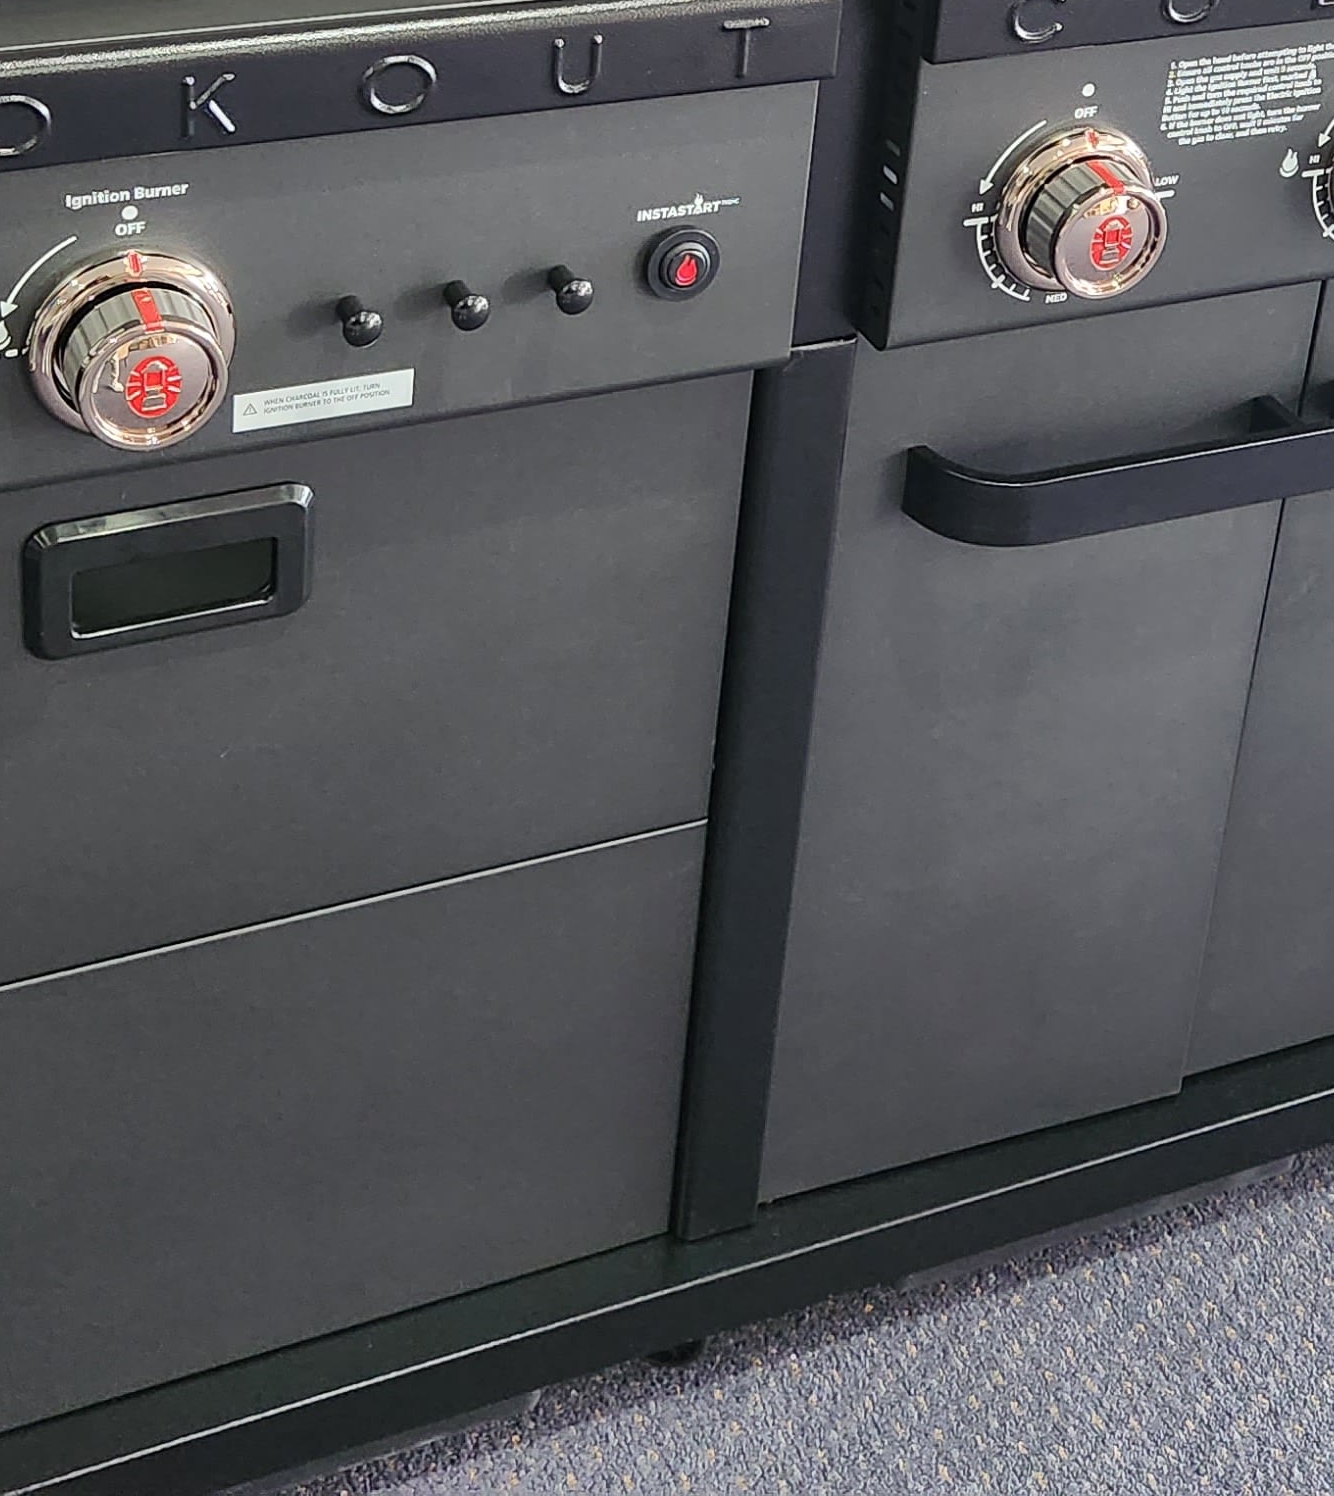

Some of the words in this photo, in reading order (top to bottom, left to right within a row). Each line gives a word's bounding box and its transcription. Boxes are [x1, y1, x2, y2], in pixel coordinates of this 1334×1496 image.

[1074, 105, 1098, 119] OFF
[1309, 155, 1320, 164] HI
[1154, 174, 1180, 186] LOW
[65, 191, 130, 209] Ignition
[133, 182, 189, 201] Burner
[636, 201, 722, 222] INSTASTART
[971, 202, 984, 213] HI
[115, 221, 146, 236] OFF
[1045, 292, 1068, 304] MED
[263, 397, 284, 407] WHEN
[285, 393, 320, 403] CHARCOAL
[329, 387, 349, 396] FULLY
[363, 383, 381, 391] TURN
[263, 404, 293, 415] IGNITION
[295, 400, 321, 409] BURNER
